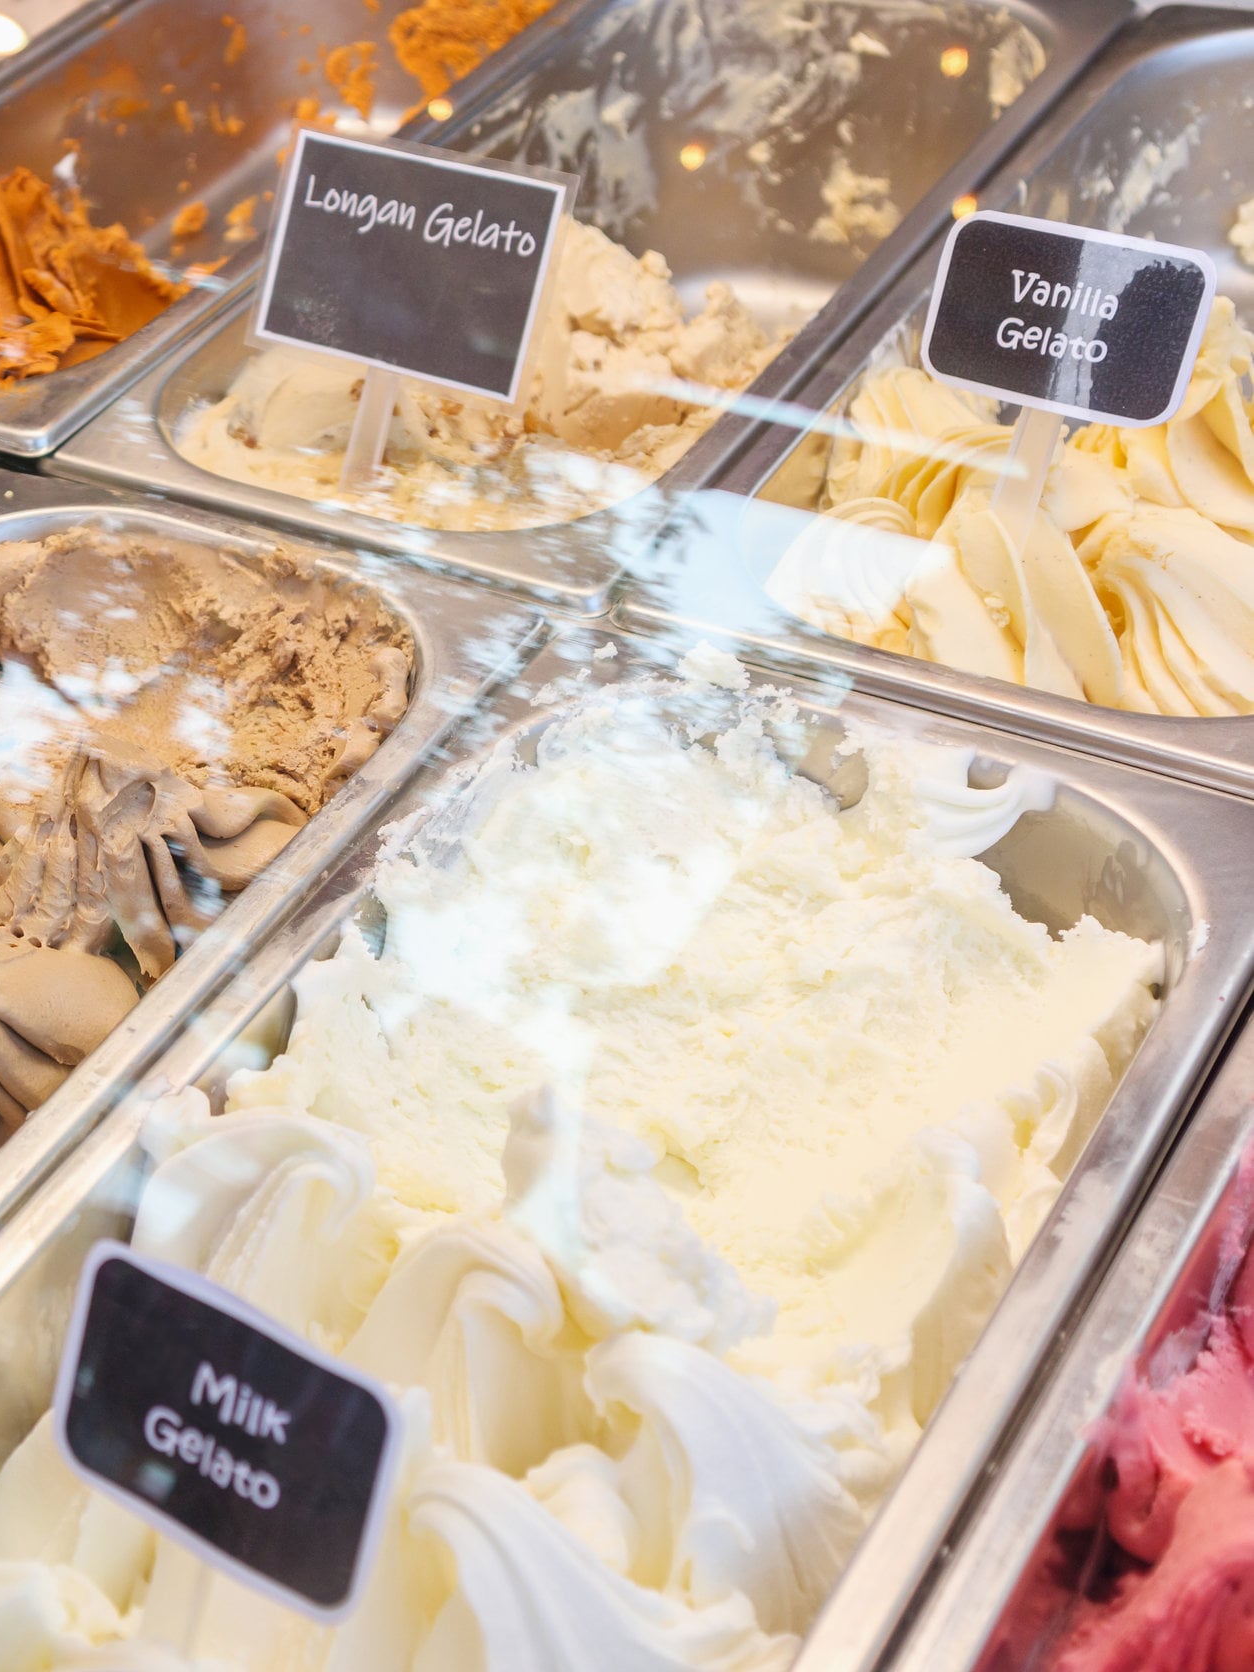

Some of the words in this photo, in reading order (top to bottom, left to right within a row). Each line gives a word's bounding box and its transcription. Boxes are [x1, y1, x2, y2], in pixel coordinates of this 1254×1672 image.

[304, 174, 416, 234] Longan
[423, 203, 536, 257] Gelato
[1011, 269, 1120, 321] Vanilla
[996, 317, 1109, 363] Gelato
[190, 1360, 292, 1445] Milk
[143, 1405, 280, 1510] Gelato
